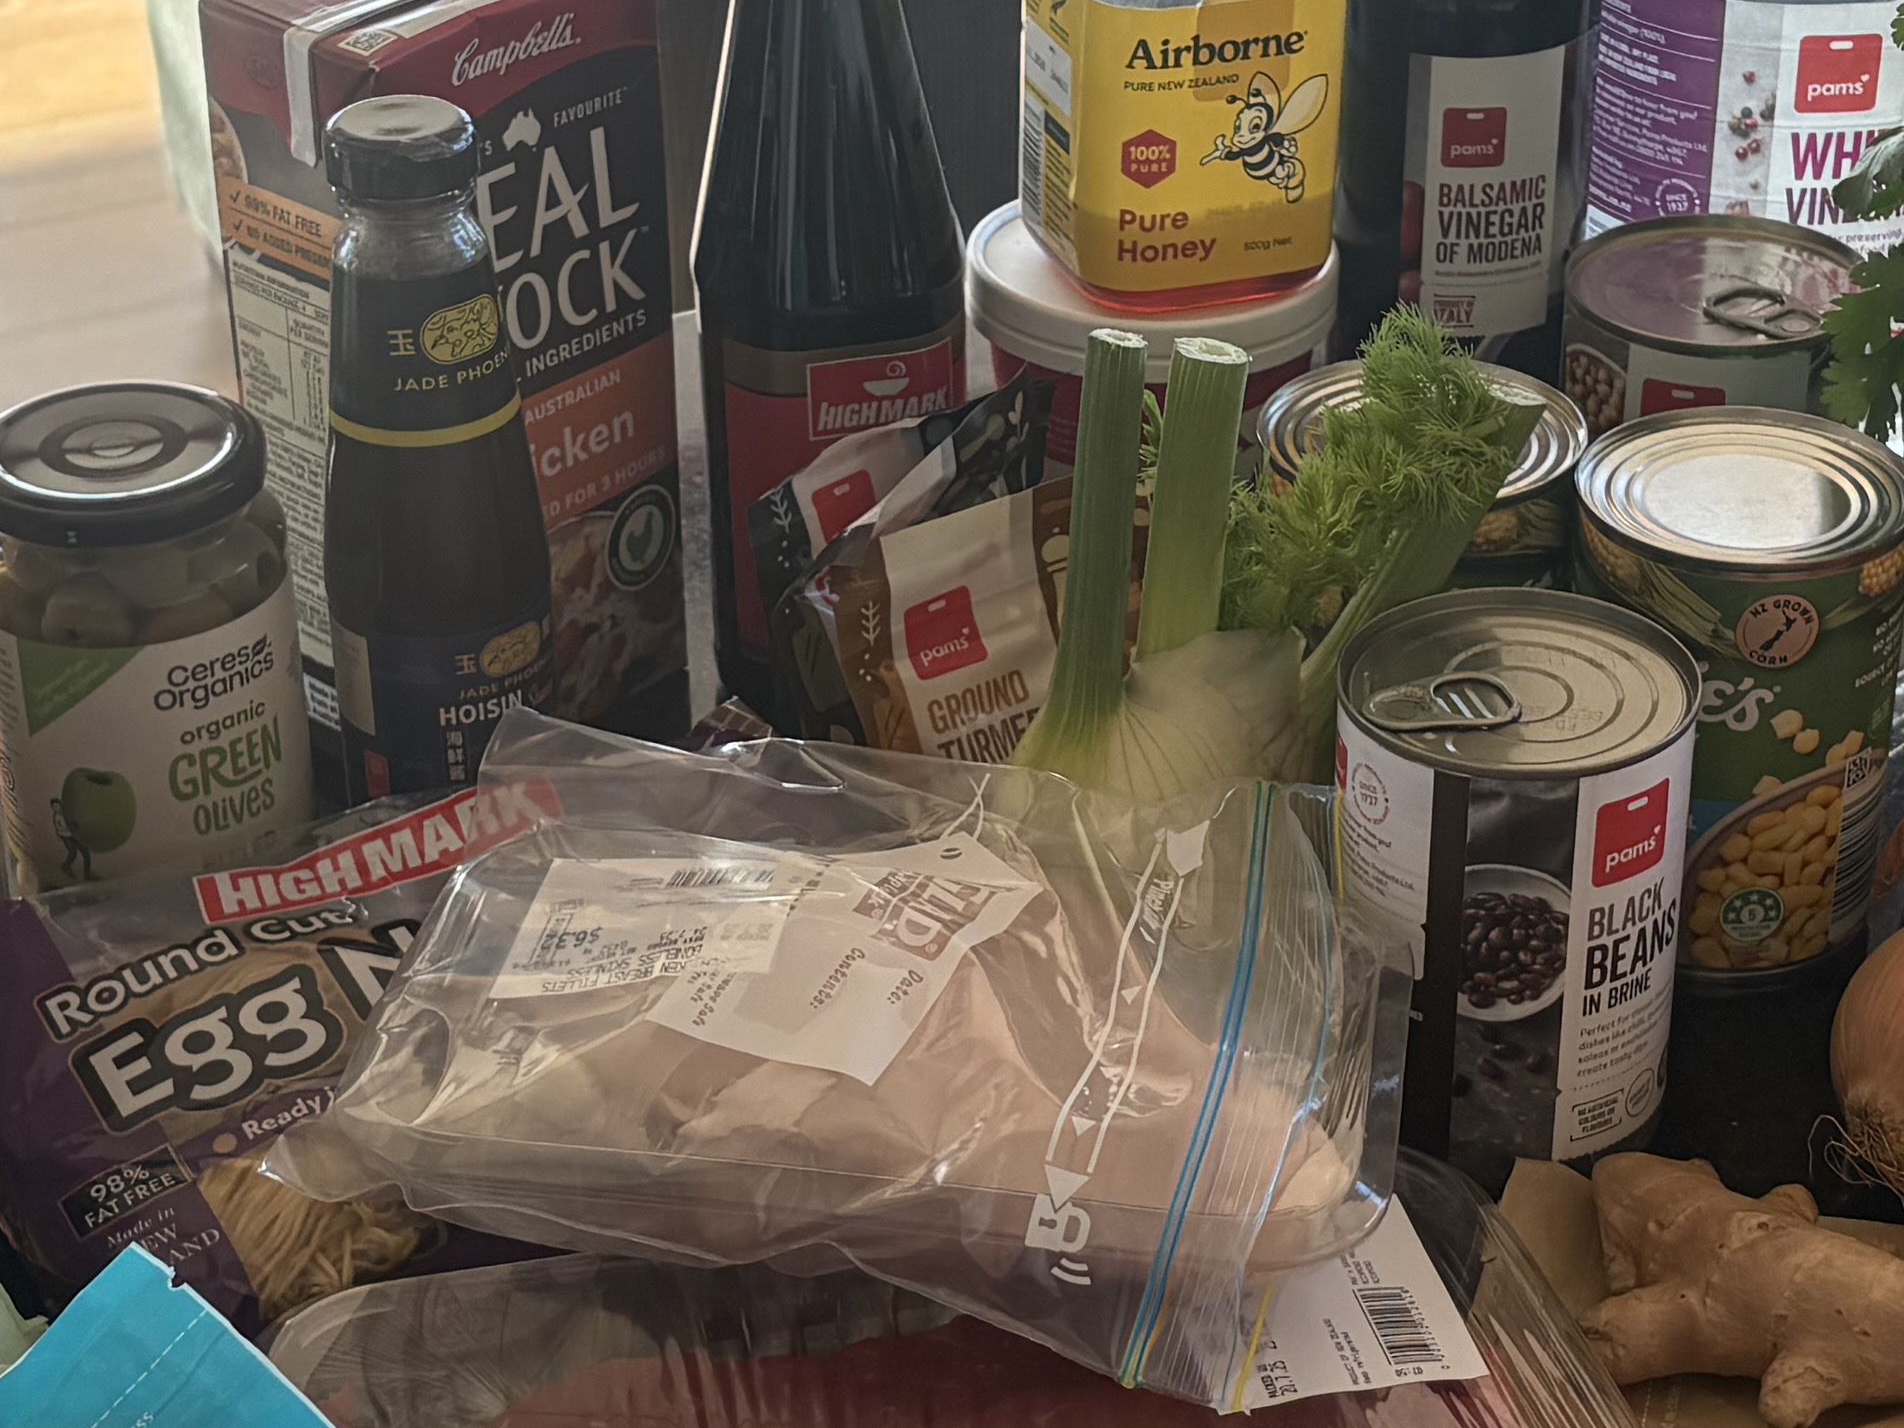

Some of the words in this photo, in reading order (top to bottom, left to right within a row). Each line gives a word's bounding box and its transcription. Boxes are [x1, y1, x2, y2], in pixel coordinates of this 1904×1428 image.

[1125, 31, 1305, 71] Airborne
[1124, 81, 1155, 92] PURE
[1157, 80, 1185, 91] NEW
[1807, 82, 1864, 102] pams
[553, 88, 624, 128] FAVOURITE
[1129, 145, 1172, 161] 100%
[1130, 162, 1169, 173] PURE
[1450, 143, 1495, 159] pams
[477, 128, 641, 273] EAL
[1438, 174, 1547, 209] BALSAMIC
[294, 215, 323, 238] FREE
[1119, 209, 1189, 233] Pure
[1438, 202, 1546, 240] VINEGAR
[1117, 238, 1217, 263] Honey
[1435, 241, 1461, 264] OF
[1467, 233, 1543, 264] MODENA
[498, 227, 647, 350] OCK
[525, 309, 647, 377] INGREDIENTS
[393, 374, 449, 392] JADE
[457, 350, 510, 385] PHOEN
[524, 368, 622, 428] AUSTRALIAN
[565, 481, 598, 510] FOR
[1773, 598, 1816, 627] GROWN
[167, 644, 252, 688] Ceres
[920, 635, 970, 667] pams
[1748, 648, 1789, 666] CORN
[154, 650, 274, 711] Organics
[180, 699, 266, 745] organic
[439, 689, 523, 727] HOISIN
[927, 669, 1030, 735] GROUND
[168, 714, 283, 801] GREEN
[1605, 835, 1658, 871] pams
[1587, 876, 1666, 943] BLACK
[1583, 898, 1679, 991] BEANS
[44, 929, 240, 1040] Round
[258, 907, 352, 946] Cut
[542, 978, 597, 992] FILLETS
[809, 946, 866, 1010] Contents:
[886, 969, 925, 1005] Date:
[1581, 992, 1602, 1017] IN
[1607, 969, 1652, 1010] BRINE
[86, 976, 328, 1119] Egg
[241, 1093, 323, 1140] Ready
[84, 1198, 121, 1228] FAT
[123, 1172, 177, 1206] FREE
[90, 1164, 150, 1203] 98%
[107, 1218, 153, 1249] Made
[157, 1207, 176, 1222] in
